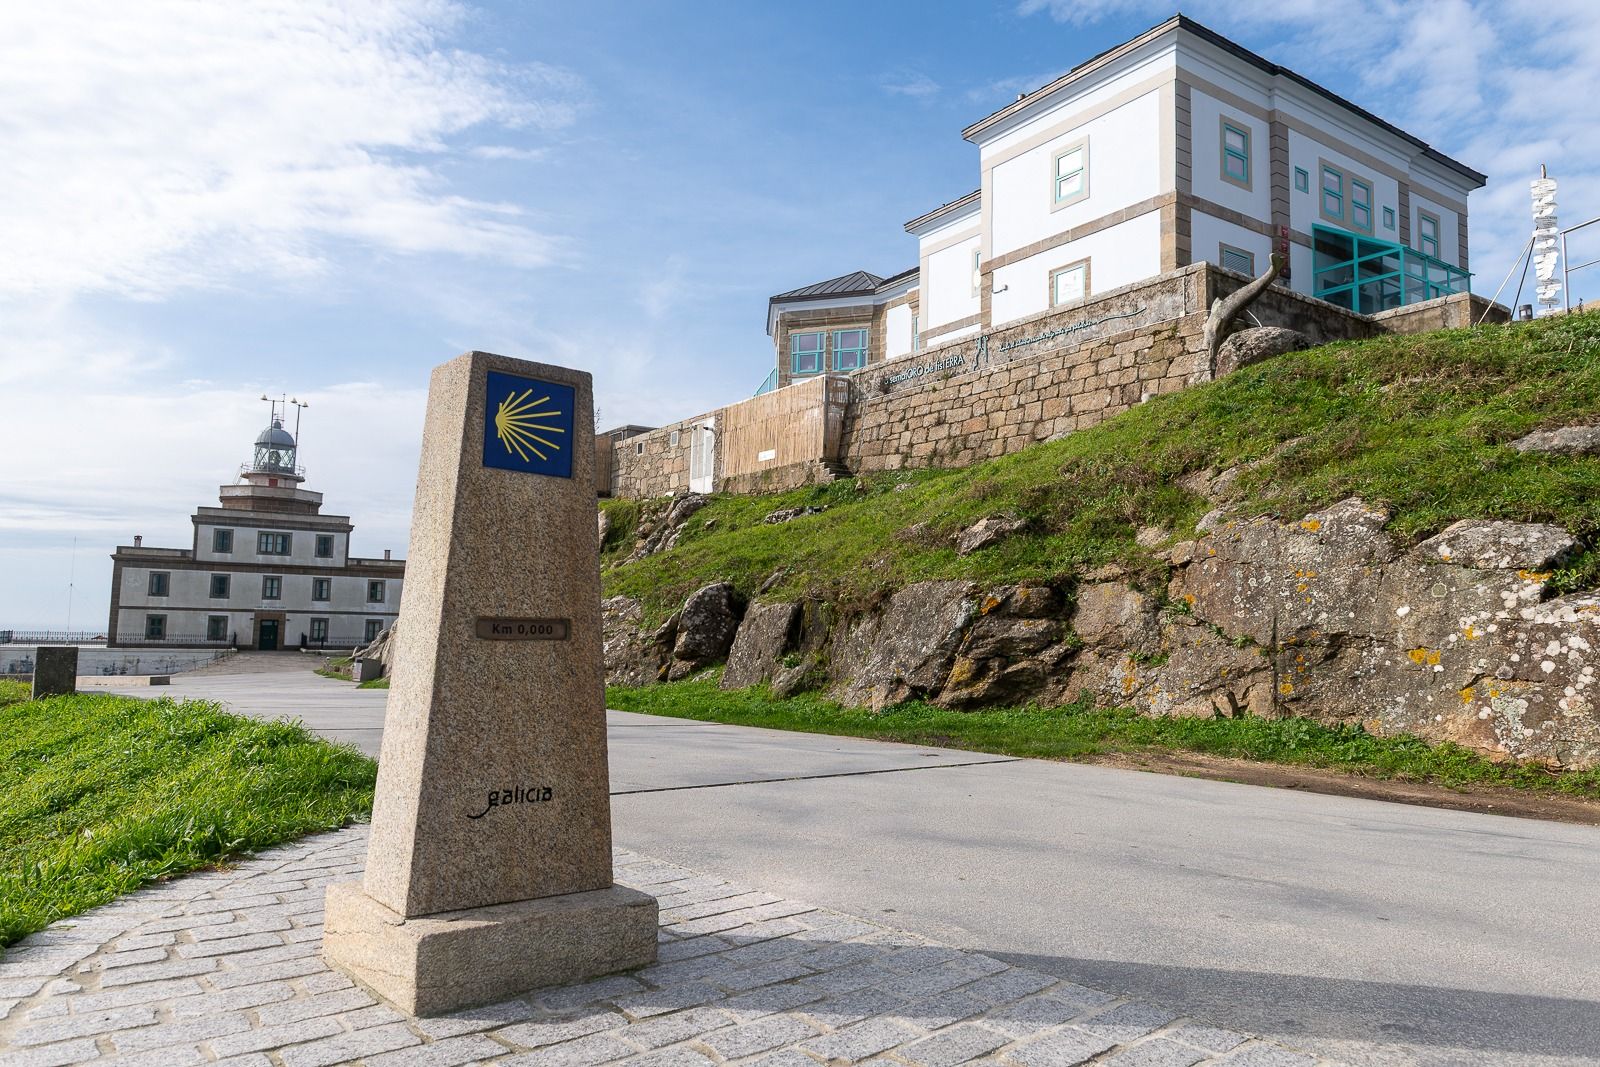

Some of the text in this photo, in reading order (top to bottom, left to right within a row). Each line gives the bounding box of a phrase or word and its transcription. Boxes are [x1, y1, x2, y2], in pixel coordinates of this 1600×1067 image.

[924, 363, 934, 375] de
[492, 623, 553, 636] Km 0,000
[467, 785, 553, 820] galicia
